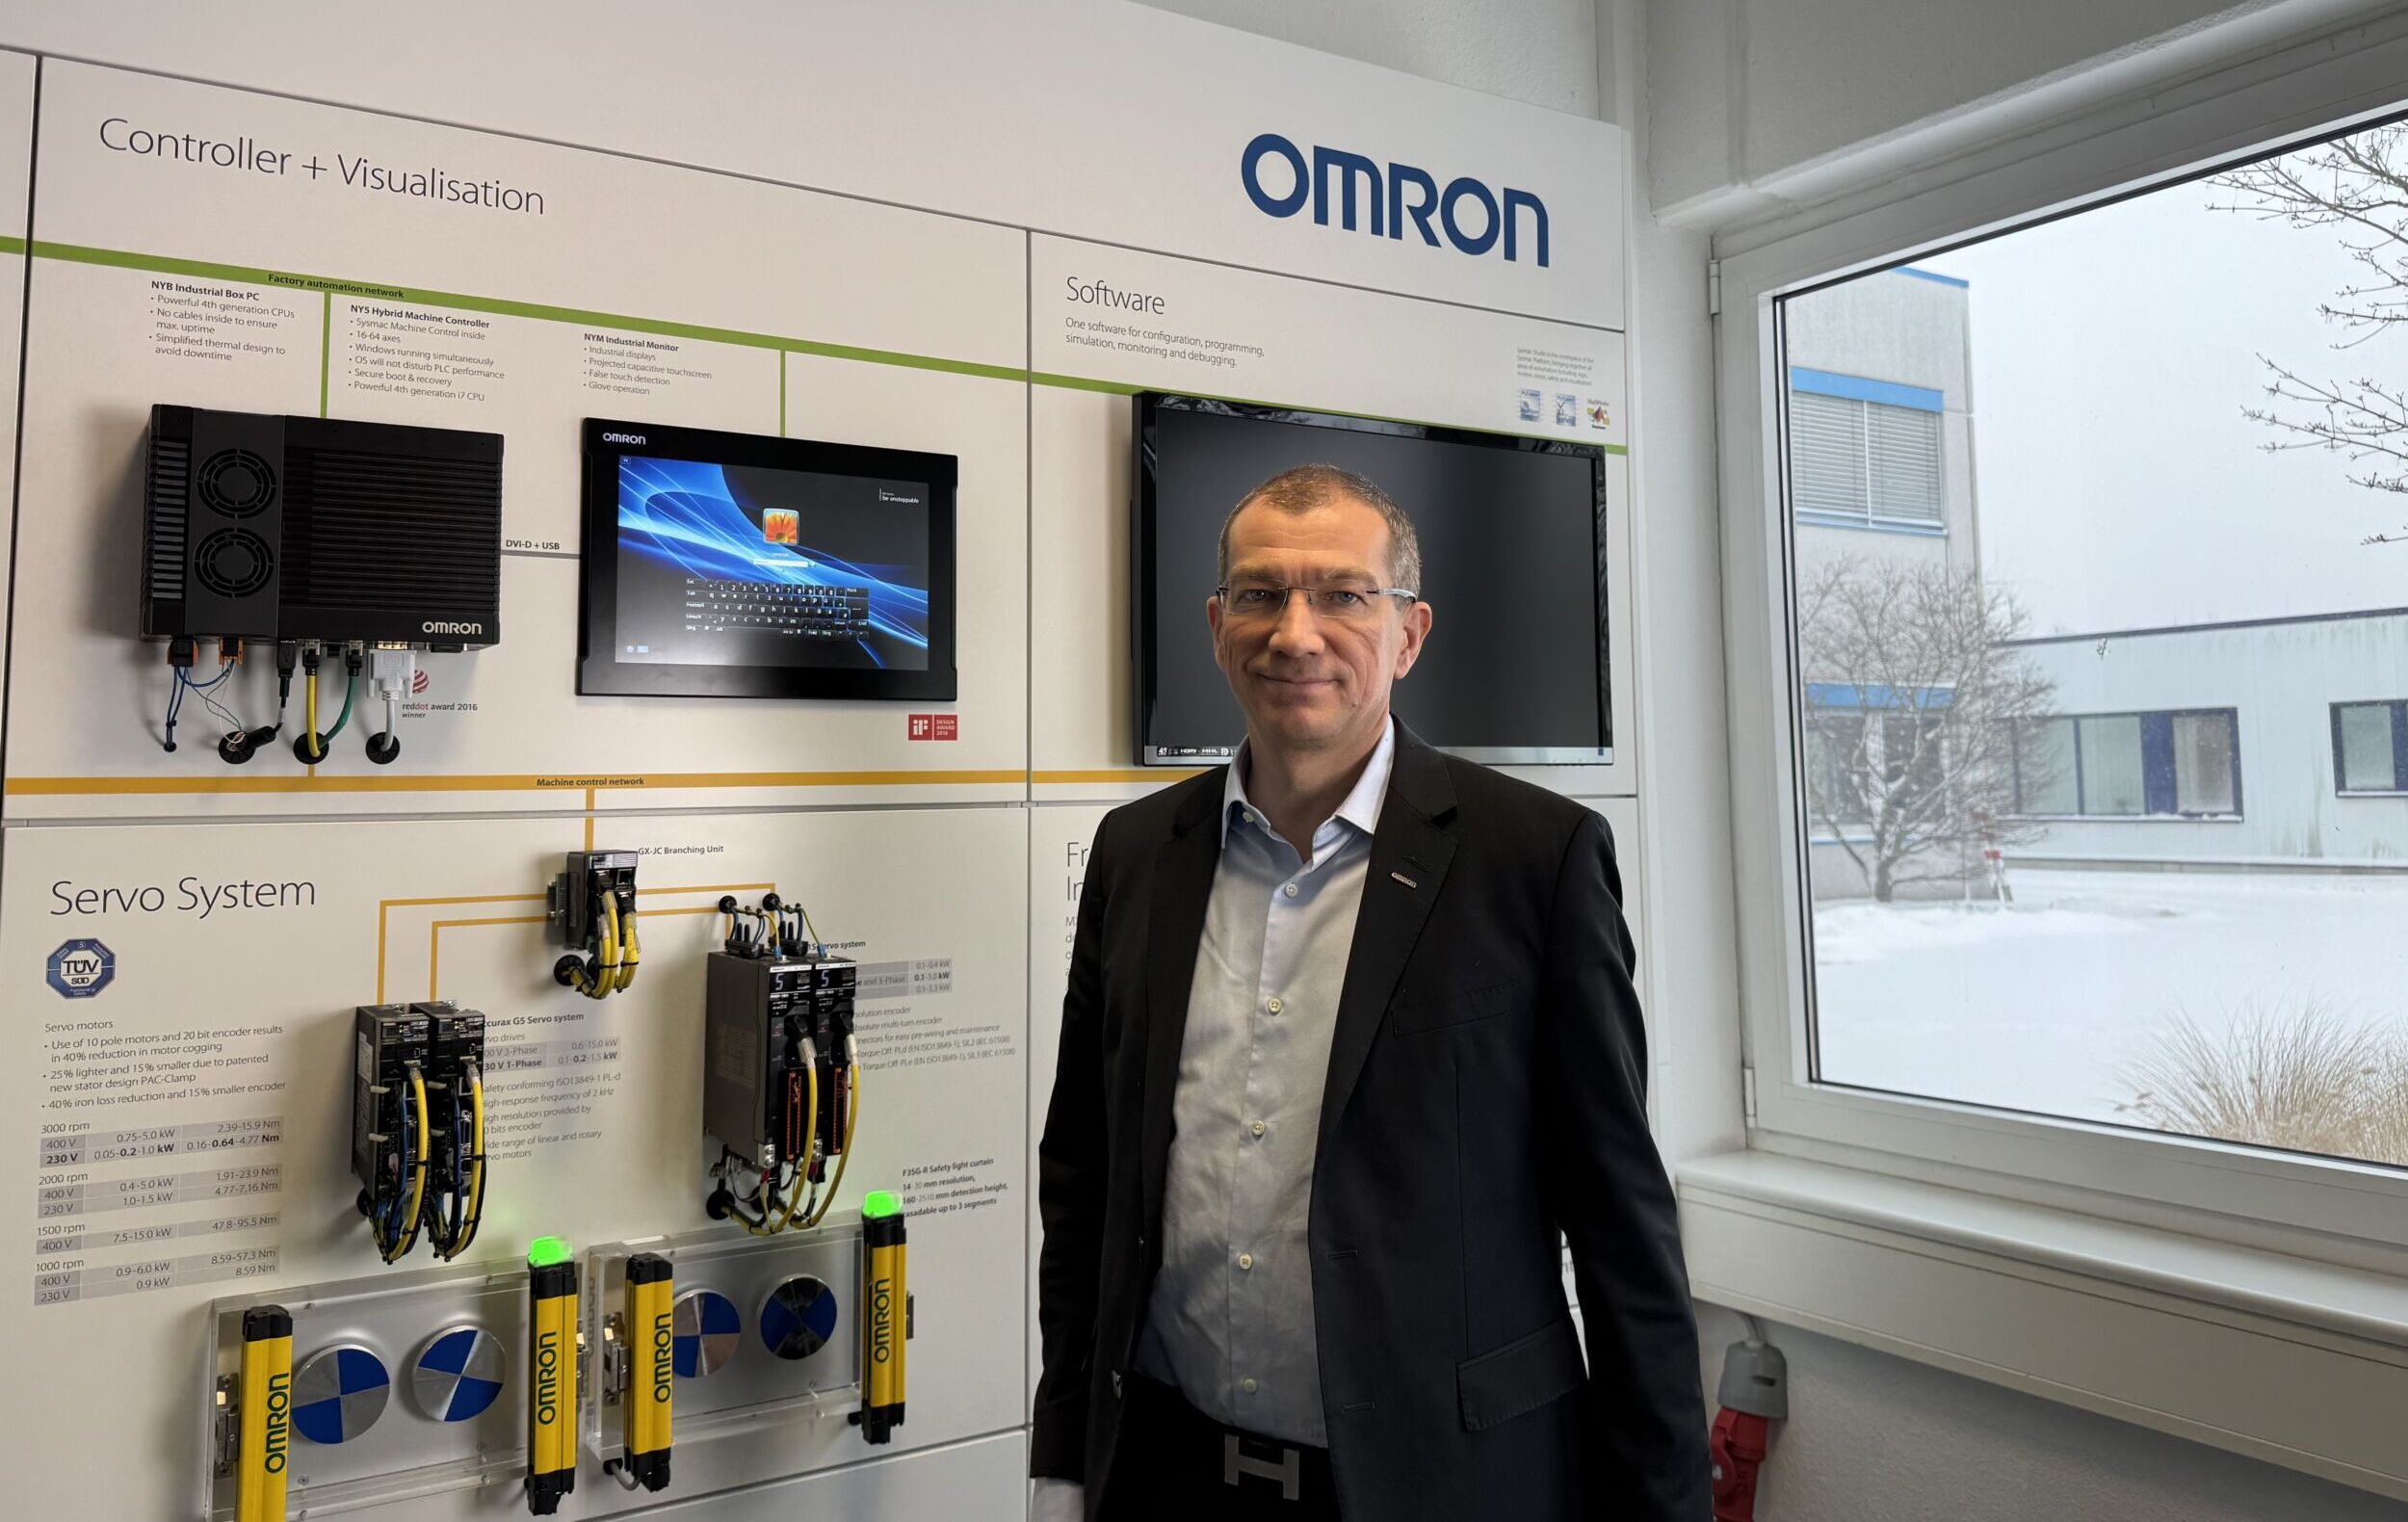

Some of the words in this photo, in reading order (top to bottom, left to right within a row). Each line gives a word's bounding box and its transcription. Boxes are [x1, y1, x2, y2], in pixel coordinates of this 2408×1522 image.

[99, 118, 292, 175] Controller
[337, 154, 544, 215] Visualisation
[1242, 133, 1550, 268] OMRON
[151, 280, 173, 291] NYB
[175, 283, 223, 297] Industrial
[225, 289, 245, 300] Box
[246, 292, 259, 302] PC
[269, 275, 304, 286] Factory
[307, 279, 362, 293] automation
[365, 285, 405, 298] network
[1066, 276, 1165, 315] Software
[157, 294, 199, 307] Powerful
[200, 300, 218, 309] 4th
[219, 303, 270, 315] generation
[271, 307, 295, 319] CPUs
[351, 304, 370, 314] NY5
[372, 306, 404, 318] Hybrid
[405, 311, 444, 324] Machine
[445, 316, 489, 328] Controller
[156, 321, 179, 330] max.
[181, 324, 216, 334] uptime
[157, 307, 171, 318] No
[172, 310, 203, 322] cables
[204, 313, 233, 325] inside
[234, 317, 245, 326] to
[246, 319, 277, 329] ensure
[356, 317, 389, 330] Sysmac
[390, 321, 427, 334] Machine
[428, 326, 459, 338] Control
[460, 329, 485, 341] inside
[357, 329, 380, 341] 16-64
[381, 334, 402, 343] axes
[1065, 317, 1086, 330] One
[1087, 321, 1127, 336] software
[1128, 326, 1140, 338] for
[1142, 330, 1203, 349] configuration,
[1204, 340, 1265, 358] programming,
[156, 332, 203, 347] Simplified
[204, 338, 241, 351] thermal
[243, 342, 274, 355] design
[275, 347, 286, 355] to
[584, 332, 605, 343] NYM
[606, 335, 645, 348] Industrial
[646, 340, 679, 353] Monitor
[1065, 332, 1116, 351] simulation,
[1117, 342, 1167, 359] monitoring
[1168, 348, 1187, 359] and
[1188, 350, 1237, 369] debugging.
[155, 347, 182, 356] avoid
[183, 348, 232, 361] downtime
[354, 342, 396, 355] Windows
[397, 349, 431, 361] running
[432, 352, 494, 368] simultaneously
[589, 345, 624, 356] Industrial
[625, 350, 656, 362] displays
[354, 367, 385, 380] Secure
[385, 370, 406, 381] boot
[407, 373, 415, 382] &
[416, 376, 453, 388] recovery
[370, 357, 384, 366] will
[385, 360, 402, 369] not
[402, 360, 432, 372] disturb
[433, 363, 451, 374] PLC
[452, 366, 505, 380] performance
[589, 356, 626, 369] Projected
[626, 363, 666, 375] capacitive
[667, 367, 712, 379] touchscreen
[589, 368, 609, 380] False
[610, 372, 633, 382] touch
[633, 374, 670, 385] detection
[353, 380, 393, 393] Powerful
[393, 385, 408, 394] 4th
[409, 387, 457, 399] generation
[458, 391, 466, 400] i7
[466, 392, 485, 402] CPU
[589, 380, 612, 393] Glove
[613, 384, 650, 395] operation
[602, 433, 646, 445] OMRON
[506, 539, 533, 549] DVI-D
[541, 541, 560, 550] USB
[422, 621, 483, 635] OMRON
[402, 701, 429, 711] reddot
[431, 702, 456, 711] award
[457, 702, 479, 711] 2016
[576, 777, 607, 786] control
[609, 776, 644, 786] network
[639, 847, 662, 855] GX-JC
[664, 846, 705, 855] Branching
[706, 845, 724, 853] Unit
[51, 880, 165, 915] Servo
[177, 877, 315, 919] System
[63, 959, 99, 974] TÜV
[44, 1023, 74, 1034] Servo
[76, 1020, 114, 1031] motors
[512, 1016, 526, 1026] G5
[527, 1015, 552, 1025] Servo
[554, 1013, 584, 1024] system
[51, 1040, 71, 1050] Use
[72, 1037, 85, 1048] of
[87, 1037, 99, 1047] 10
[100, 1036, 123, 1049] pole
[124, 1035, 160, 1044] motors
[162, 1031, 181, 1042] and
[183, 1031, 196, 1040] 20
[196, 1030, 210, 1042] bit
[212, 1027, 251, 1038] encoder
[253, 1025, 283, 1036] results
[51, 1054, 61, 1063] in
[63, 1051, 87, 1063] 40%
[88, 1048, 137, 1061] reduction
[139, 1047, 148, 1057] in
[150, 1046, 181, 1056] motor
[182, 1042, 222, 1056] cogging
[50, 1069, 74, 1080] 25%
[75, 1066, 109, 1080] lighter
[110, 1063, 130, 1075] and
[133, 1063, 154, 1073] 15%
[156, 1061, 191, 1071] smaller
[193, 1059, 211, 1068] due
[214, 1056, 224, 1067] to
[225, 1053, 269, 1068] patented
[49, 1084, 72, 1093] new
[74, 1079, 103, 1091] stator
[105, 1077, 139, 1089] design
[141, 1073, 196, 1086] PAC-Clamp
[40, 1122, 66, 1135] 3000
[68, 1122, 91, 1134] rpm
[117, 1130, 157, 1143] 0.75-5.0
[159, 1128, 175, 1139] kW
[46, 1139, 66, 1149] 400
[68, 1138, 76, 1148] V
[46, 1154, 67, 1165] 230
[69, 1152, 78, 1162] V
[903, 1167, 929, 1176] F3SG-R
[929, 1164, 952, 1173] Safety
[952, 1161, 969, 1171] light
[969, 1158, 994, 1168] curtain
[39, 1173, 65, 1186] 2000
[66, 1172, 89, 1185] rpm
[873, 1277, 892, 1364] OMRON
[653, 1312, 672, 1404] OMRON
[537, 1330, 558, 1427] OMRON
[264, 1372, 289, 1474] OMRON
